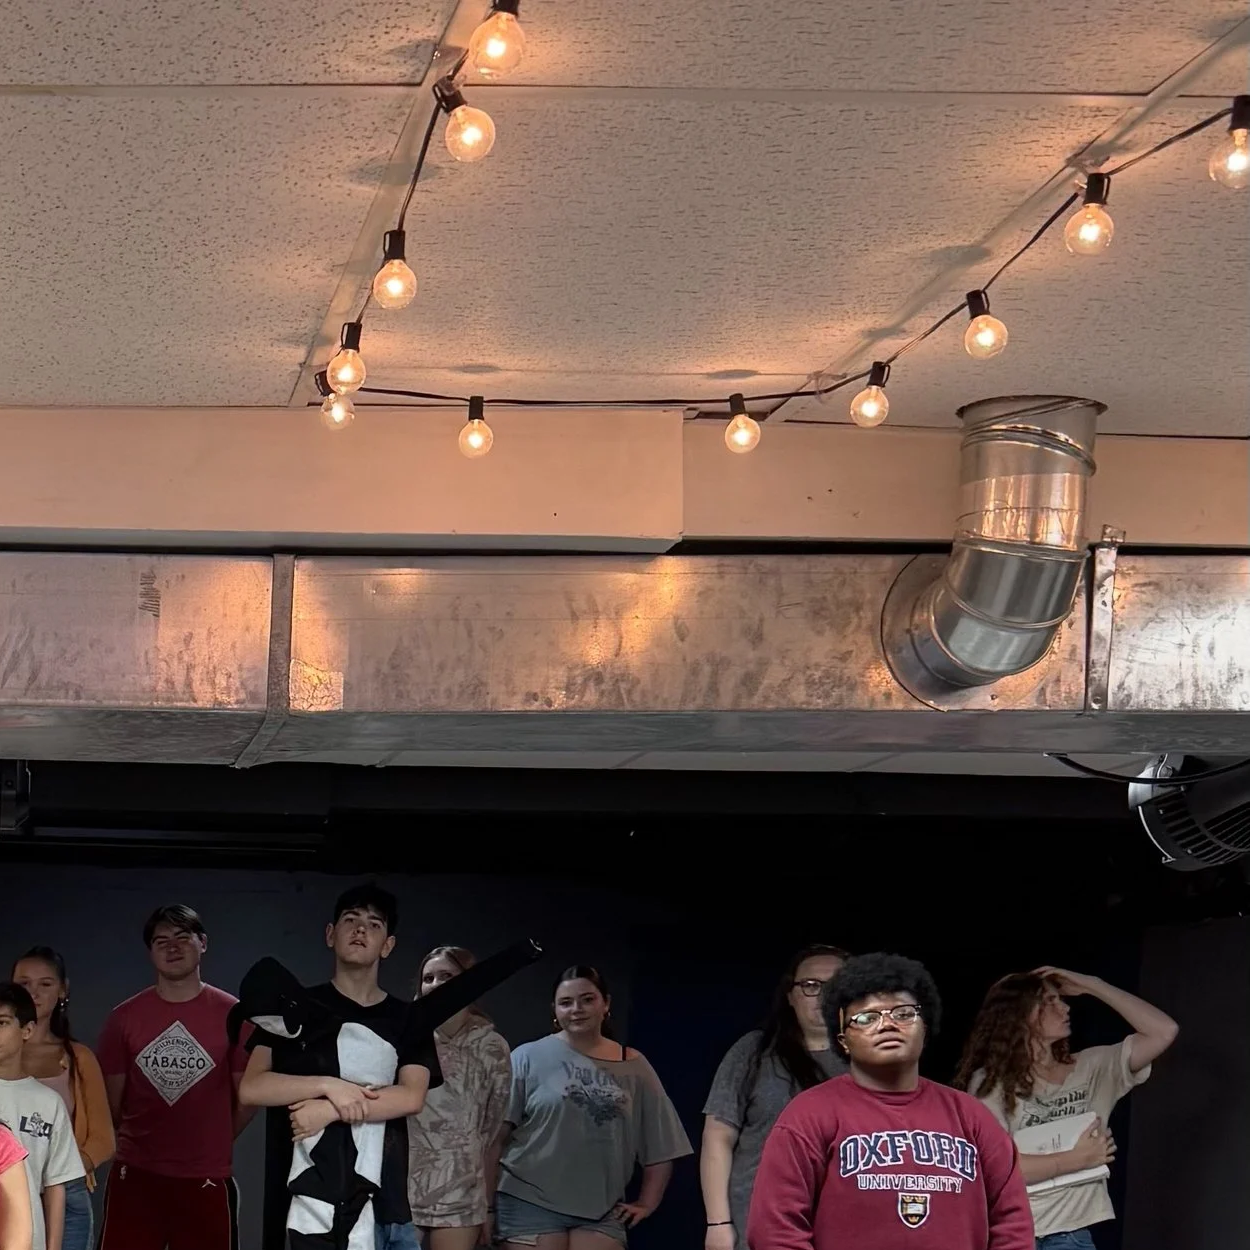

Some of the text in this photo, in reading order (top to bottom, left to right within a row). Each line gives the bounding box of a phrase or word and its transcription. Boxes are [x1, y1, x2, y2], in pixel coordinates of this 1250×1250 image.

[142, 1055, 206, 1070] TABASCO
[839, 1129, 978, 1182] OXFORD
[856, 1173, 963, 1193] UNIVERSITY
